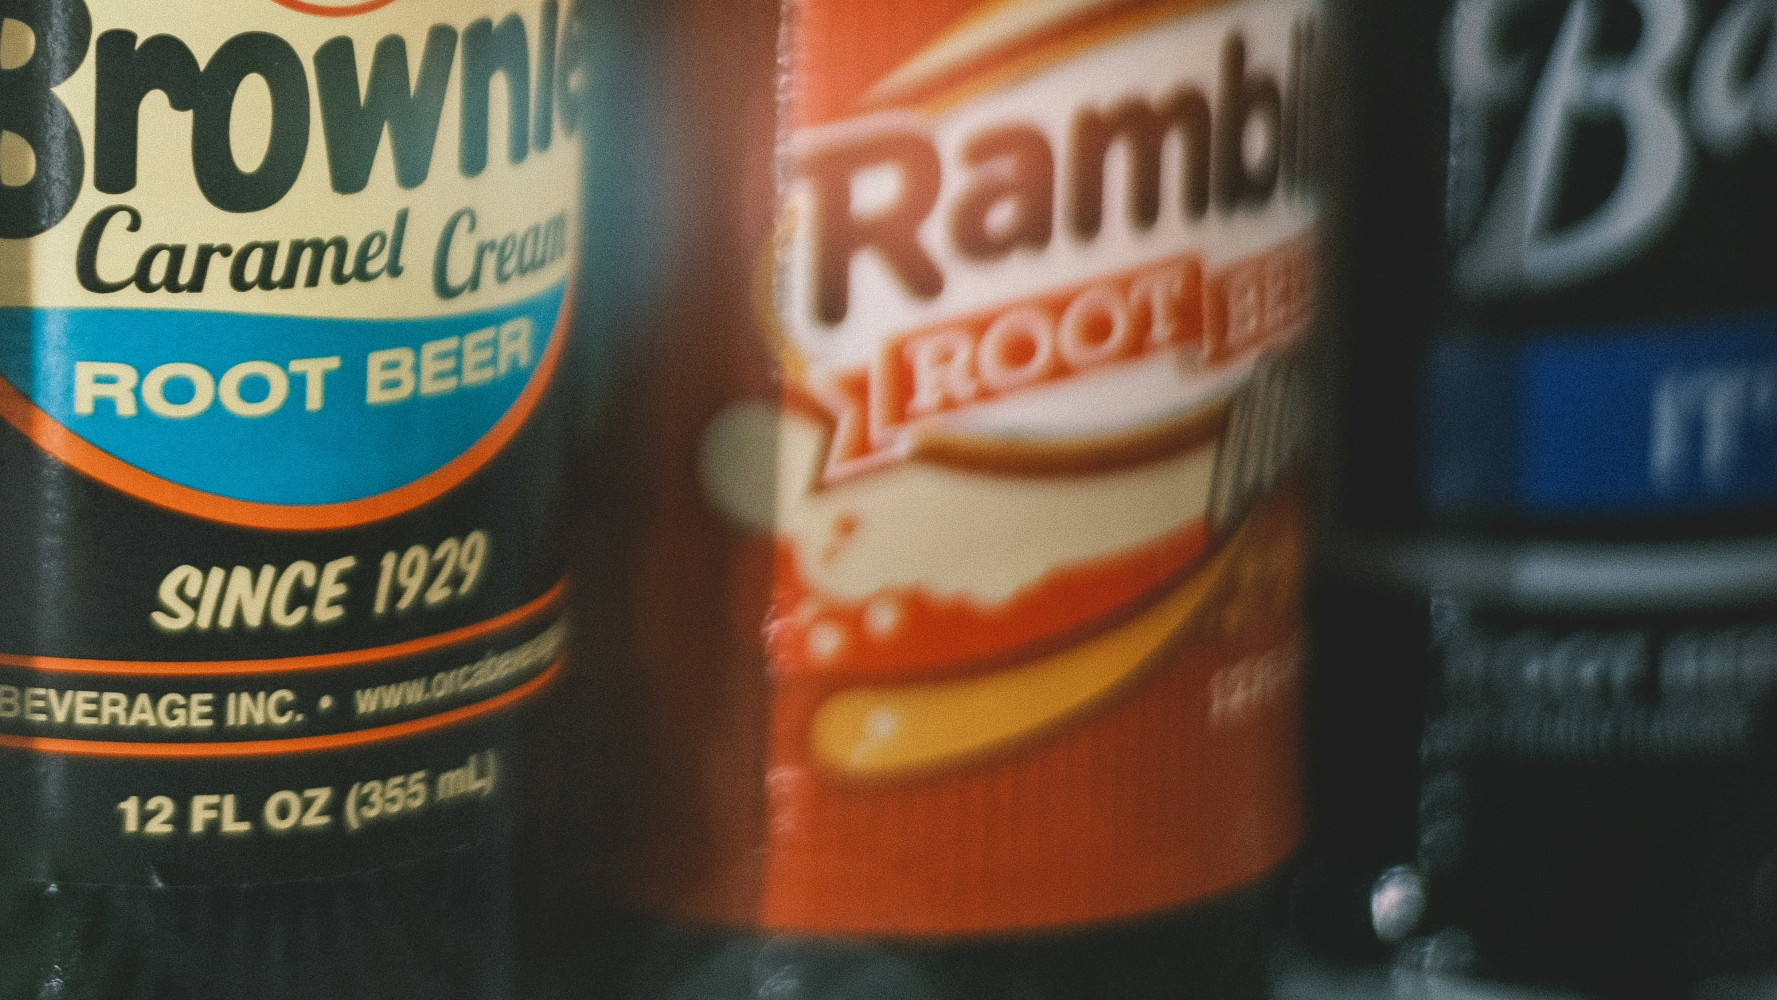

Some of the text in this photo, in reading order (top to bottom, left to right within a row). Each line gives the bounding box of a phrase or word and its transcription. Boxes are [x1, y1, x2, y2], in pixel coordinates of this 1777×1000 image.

[75, 203, 566, 301] Caramel Cream
[74, 316, 536, 419] ROOT BEER
[908, 272, 1185, 412] ROOT
[150, 529, 490, 632] SINCE 1929
[226, 687, 304, 727] INC.
[117, 795, 175, 834] 12
[190, 794, 253, 834] FL
[264, 786, 334, 830] OZ
[345, 769, 428, 831] (355
